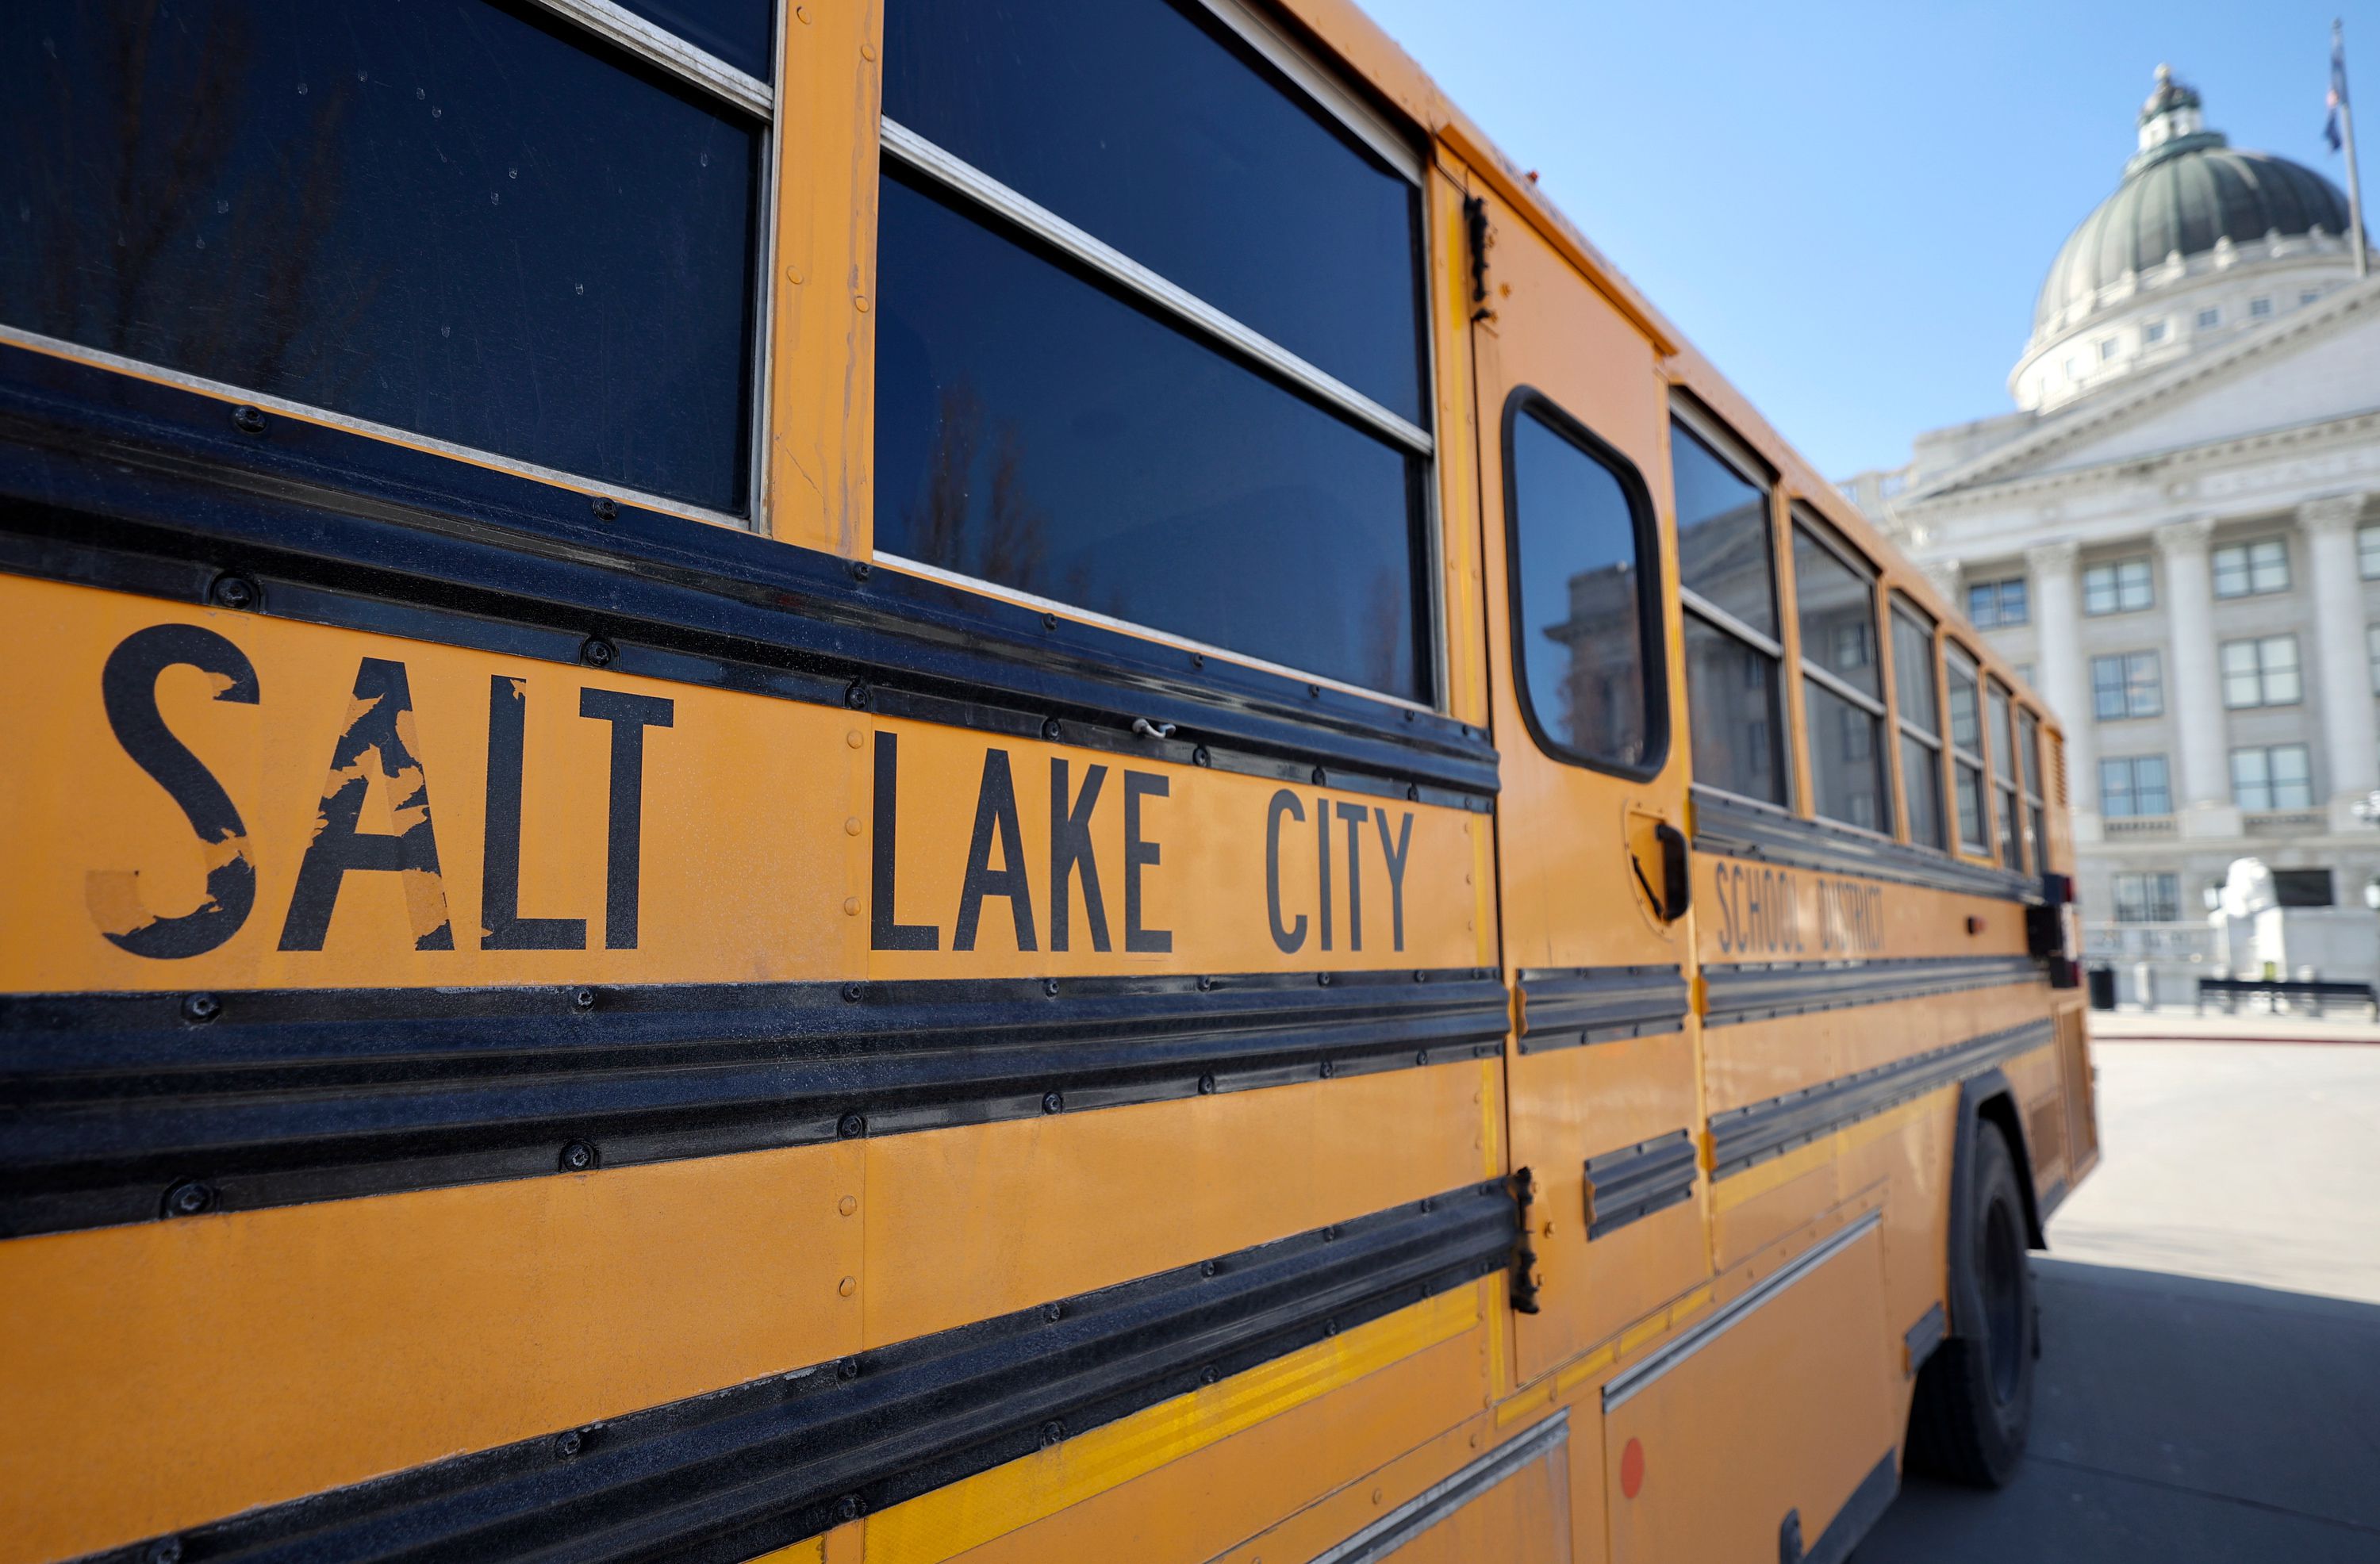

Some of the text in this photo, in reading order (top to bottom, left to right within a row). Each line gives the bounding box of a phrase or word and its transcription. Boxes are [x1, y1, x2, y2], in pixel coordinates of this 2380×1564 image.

[86, 623, 674, 960] SALT
[870, 730, 1173, 954] LAKE
[1266, 788, 1415, 954] CITY
[1715, 861, 1805, 953] SCHOOL
